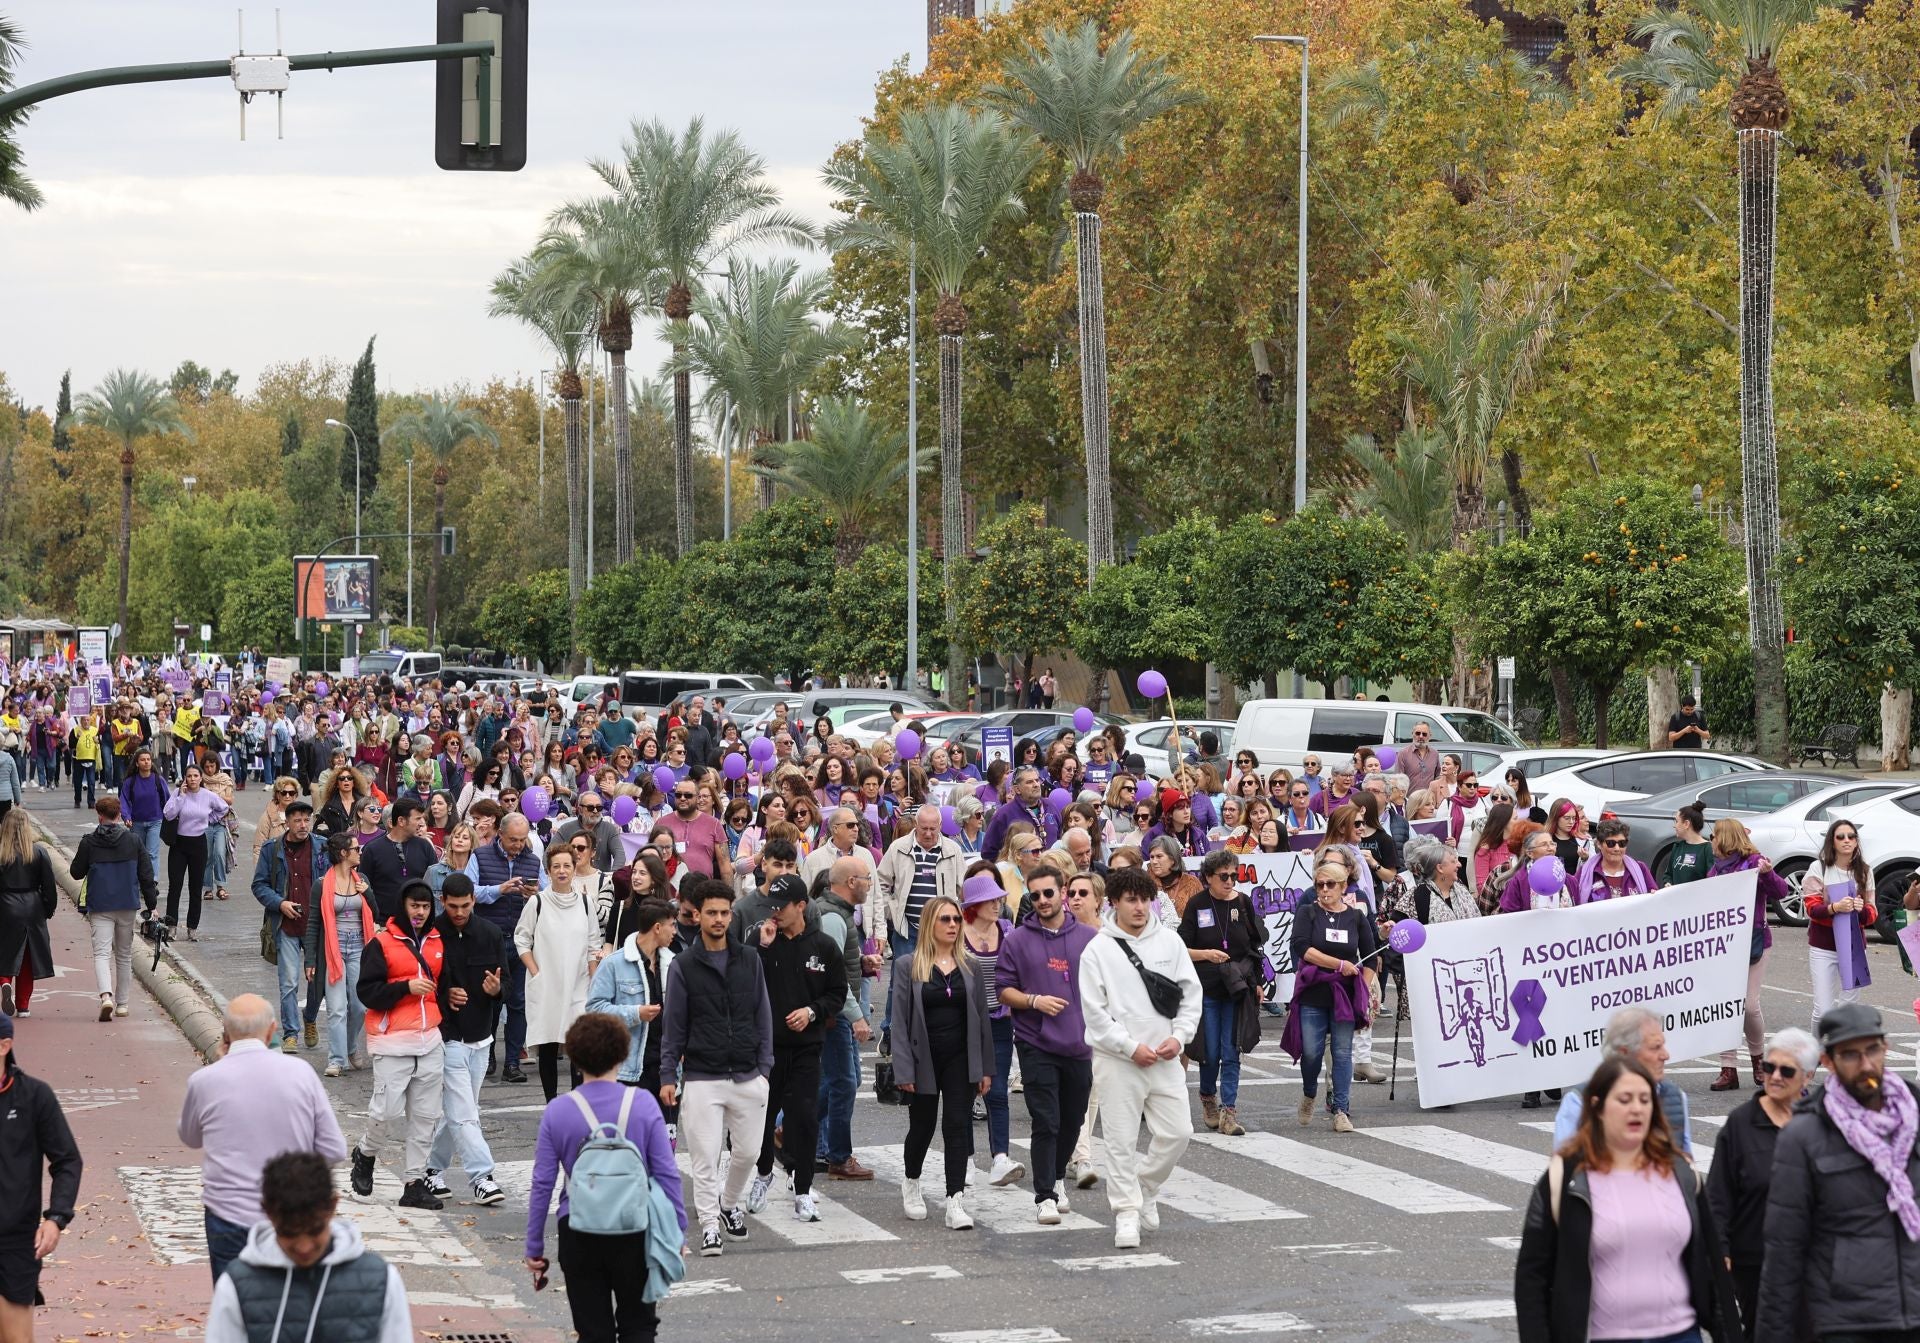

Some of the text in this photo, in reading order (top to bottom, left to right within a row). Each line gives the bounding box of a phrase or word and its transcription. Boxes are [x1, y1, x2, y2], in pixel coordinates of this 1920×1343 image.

[1522, 906, 1747, 966] ASOCIACIÓN DE MUJERES
[1542, 933, 1735, 988] “VENTANA ABIERTA”
[1591, 976, 1694, 1011] POZOBLANCO
[1532, 1038, 1557, 1058] NO
[1563, 1035, 1580, 1054] AL
